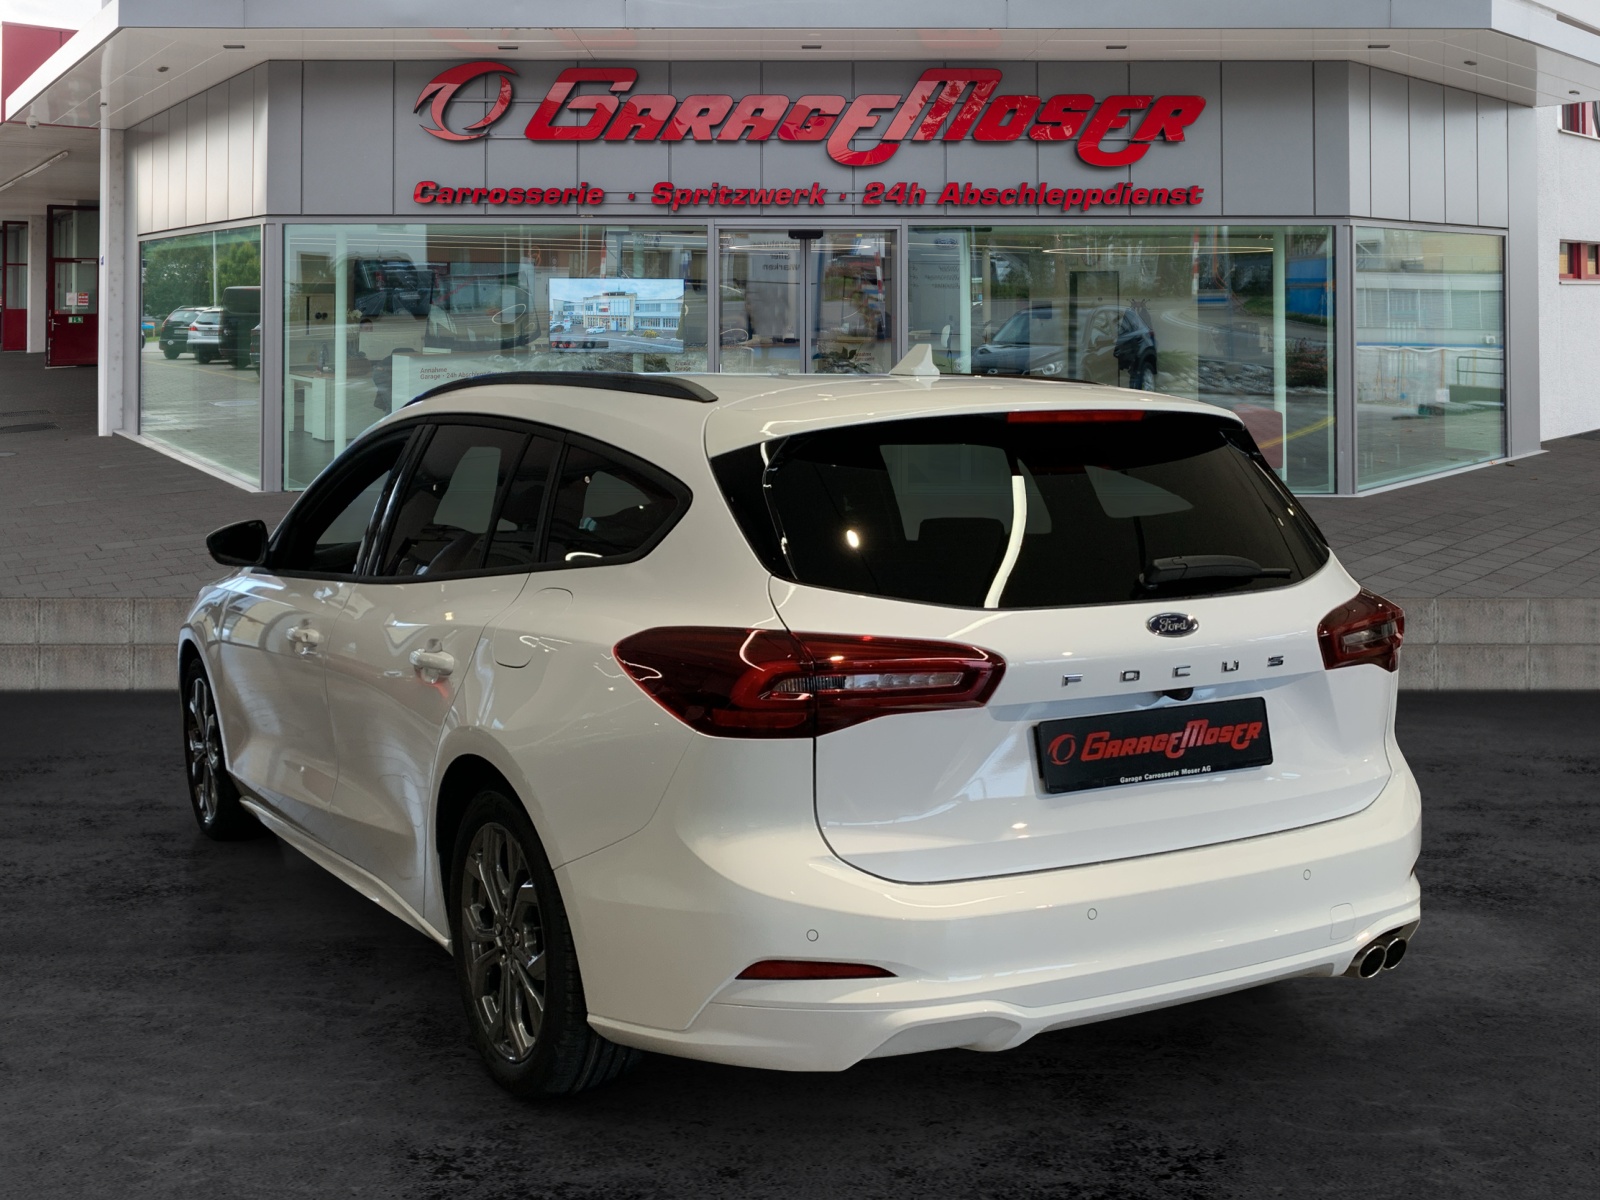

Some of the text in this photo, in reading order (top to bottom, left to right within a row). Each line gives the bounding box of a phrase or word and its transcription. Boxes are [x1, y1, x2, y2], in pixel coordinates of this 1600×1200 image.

[413, 181, 1204, 211] Carrosserie Spritzwerk 24h Abschleppdienst
[1159, 617, 1187, 632] Ford
[1061, 656, 1284, 687] FOCUS
[1144, 770, 1179, 780] Carrosserie
[1181, 767, 1201, 775] Moser
